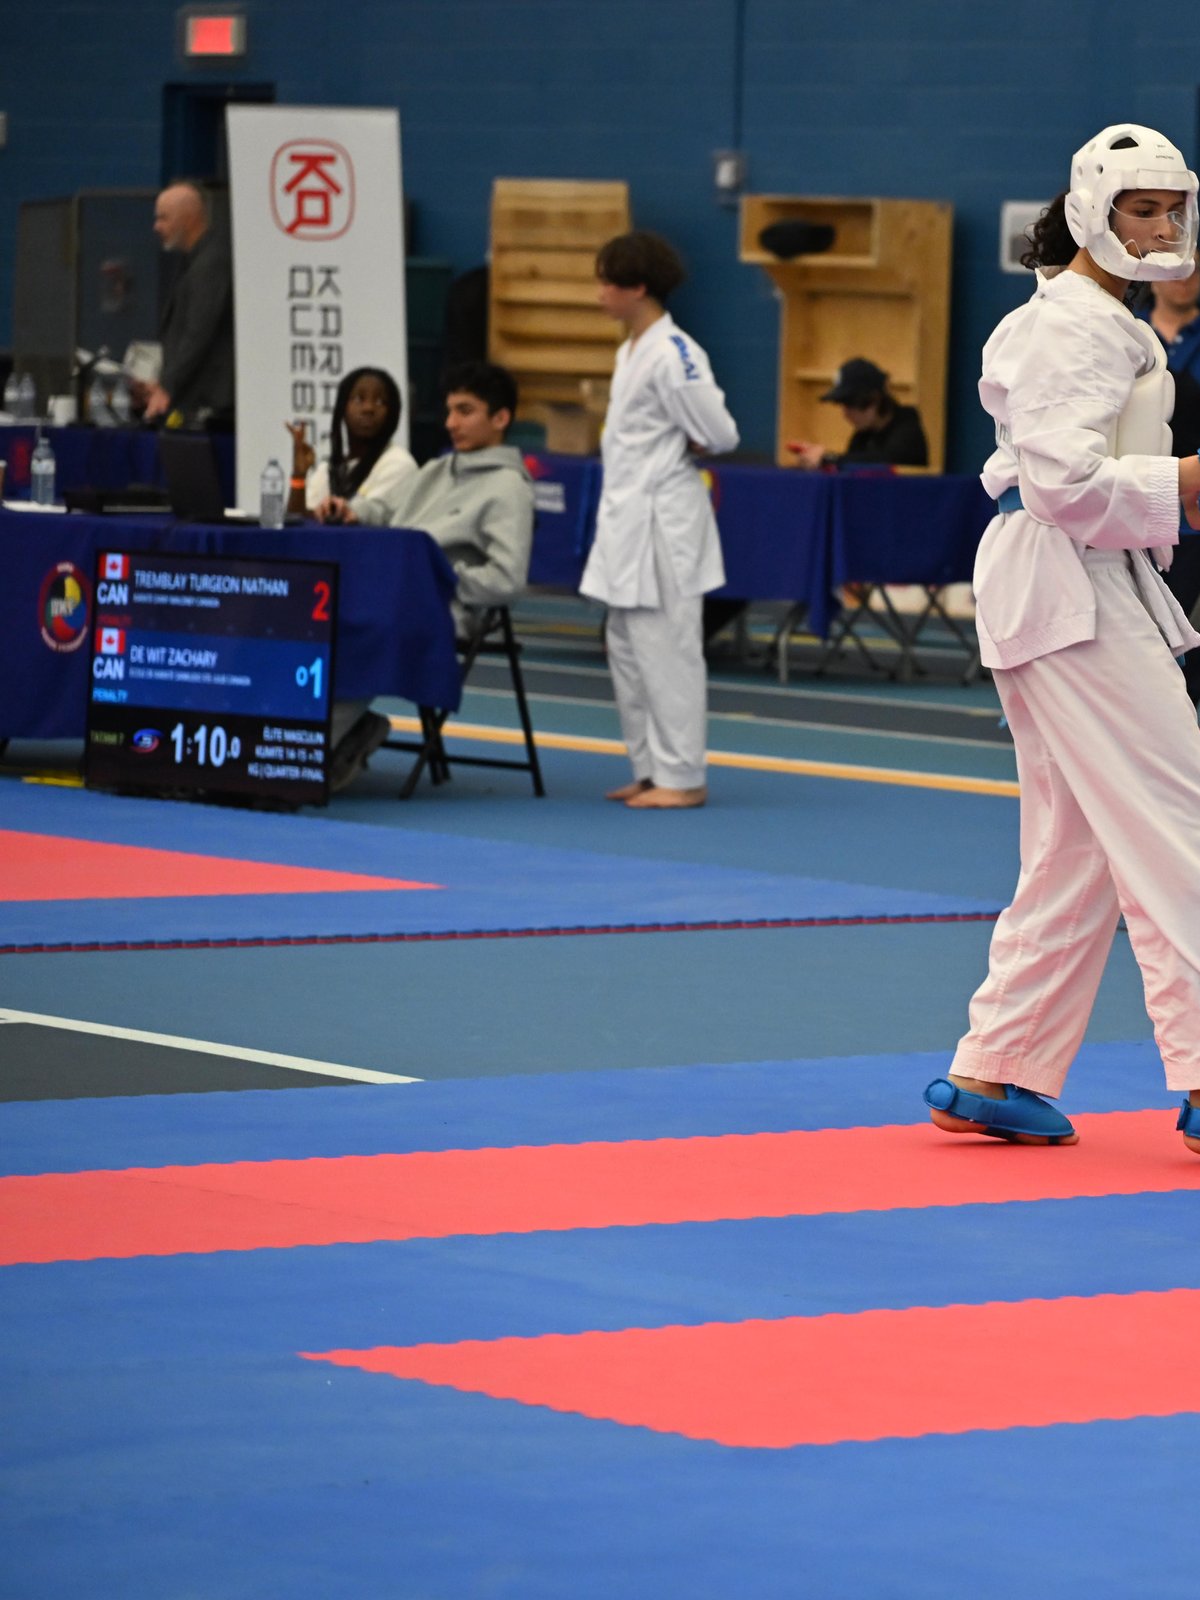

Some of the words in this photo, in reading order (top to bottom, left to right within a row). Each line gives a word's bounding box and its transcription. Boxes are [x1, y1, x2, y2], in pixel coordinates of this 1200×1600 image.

[96, 581, 129, 606] CAN
[135, 570, 187, 591] TREMBLAY
[189, 572, 240, 595] TURGEON
[241, 576, 289, 598] NATHAN
[311, 580, 330, 622] 2
[92, 656, 125, 681] CAN
[130, 644, 145, 664] DE
[146, 646, 167, 665] WIT
[168, 647, 218, 669] ZACHARY
[92, 687, 129, 703] PENALTY
